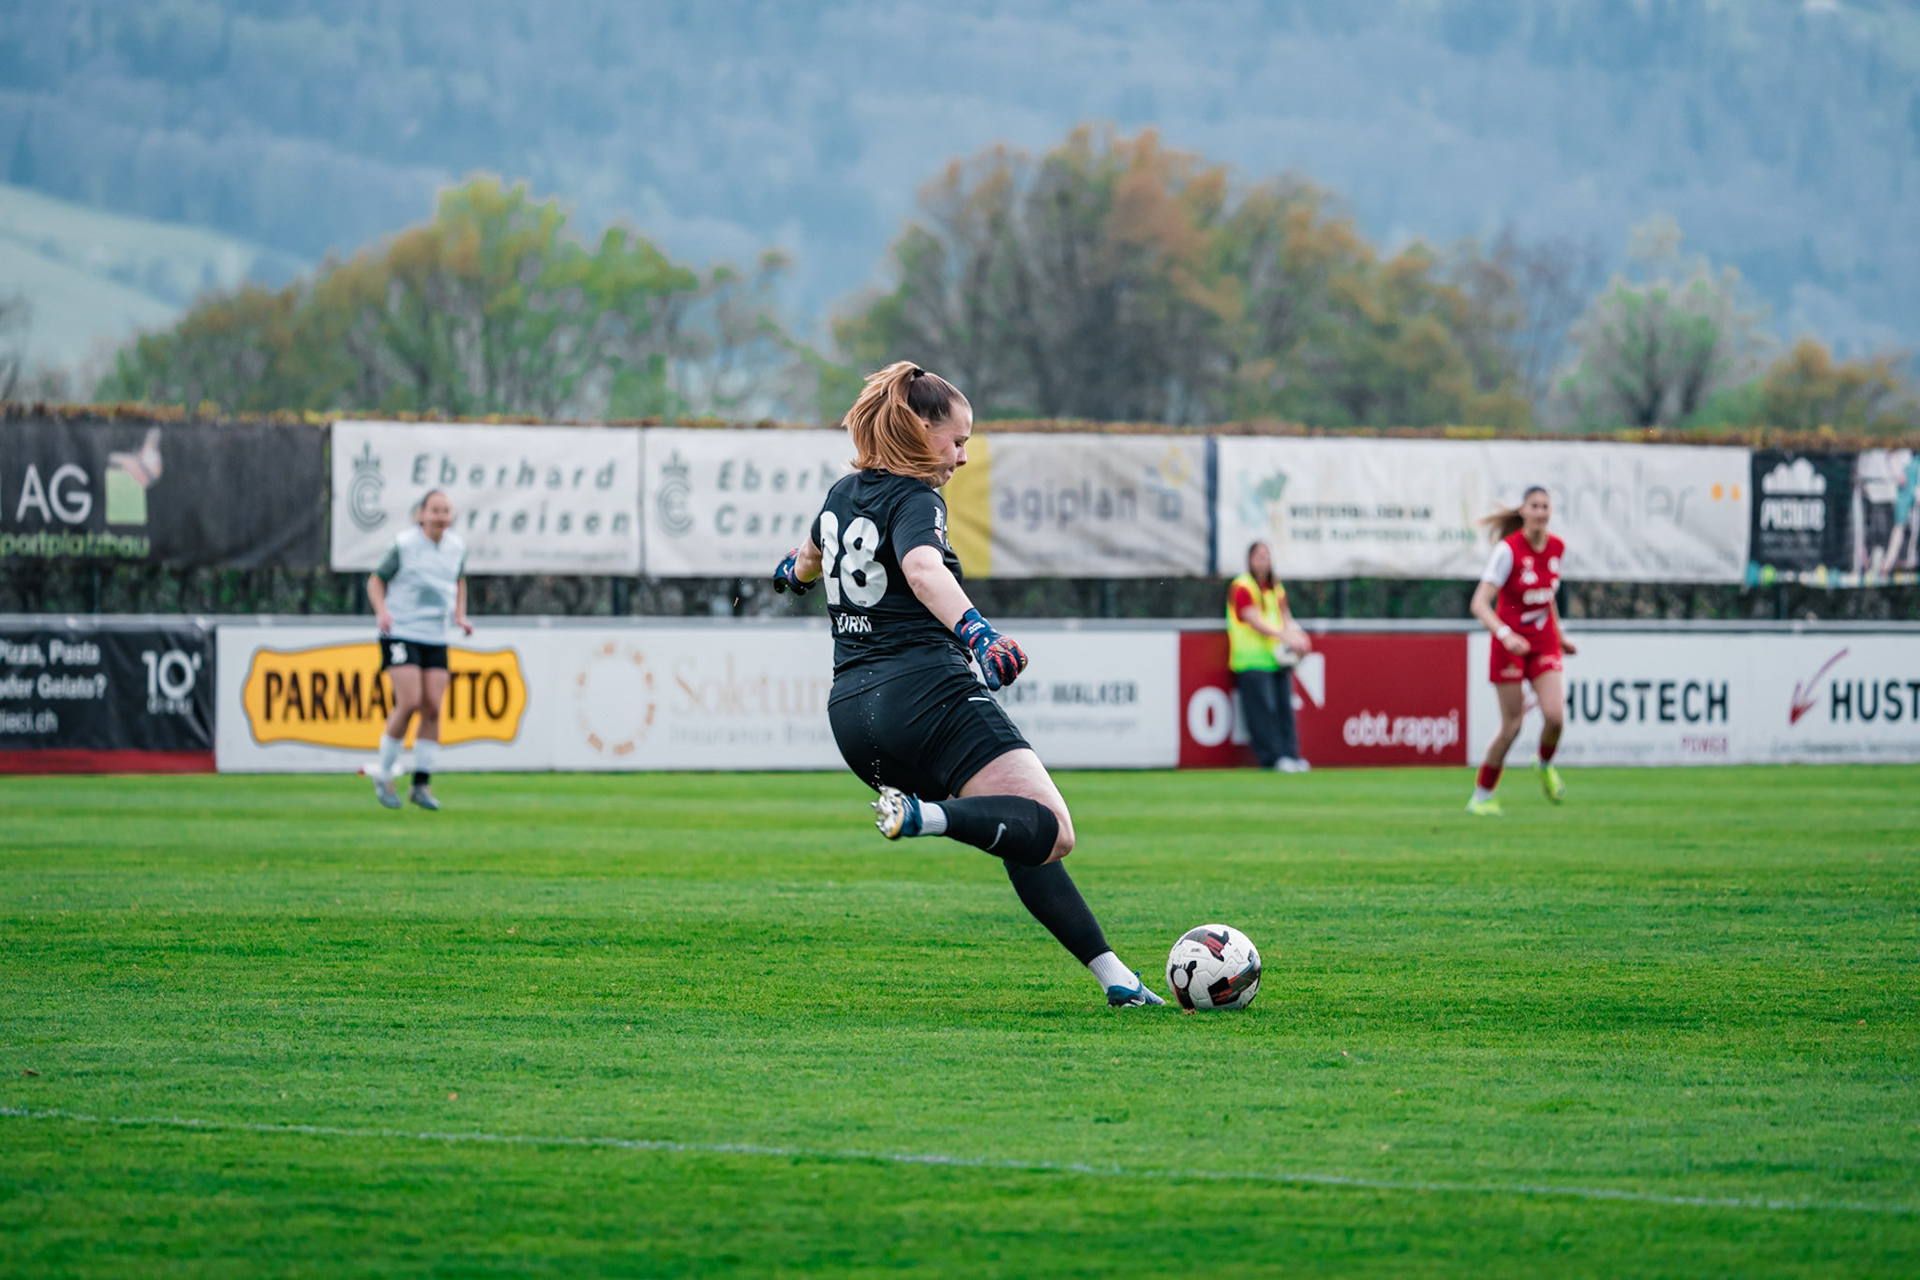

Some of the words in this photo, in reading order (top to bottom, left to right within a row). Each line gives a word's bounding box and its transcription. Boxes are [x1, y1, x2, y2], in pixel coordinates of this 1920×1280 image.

[411, 453, 617, 489] Eberhard
[717, 459, 839, 491] Eberh
[16, 463, 93, 524] AG
[998, 480, 1138, 532] agiplan
[410, 499, 630, 535] rreisen
[715, 503, 807, 535] Carr
[49, 638, 101, 666] Pasta
[37, 673, 107, 699] Gelato?
[263, 670, 510, 722] PARMATTO
[1343, 709, 1460, 754] obt.rappi
